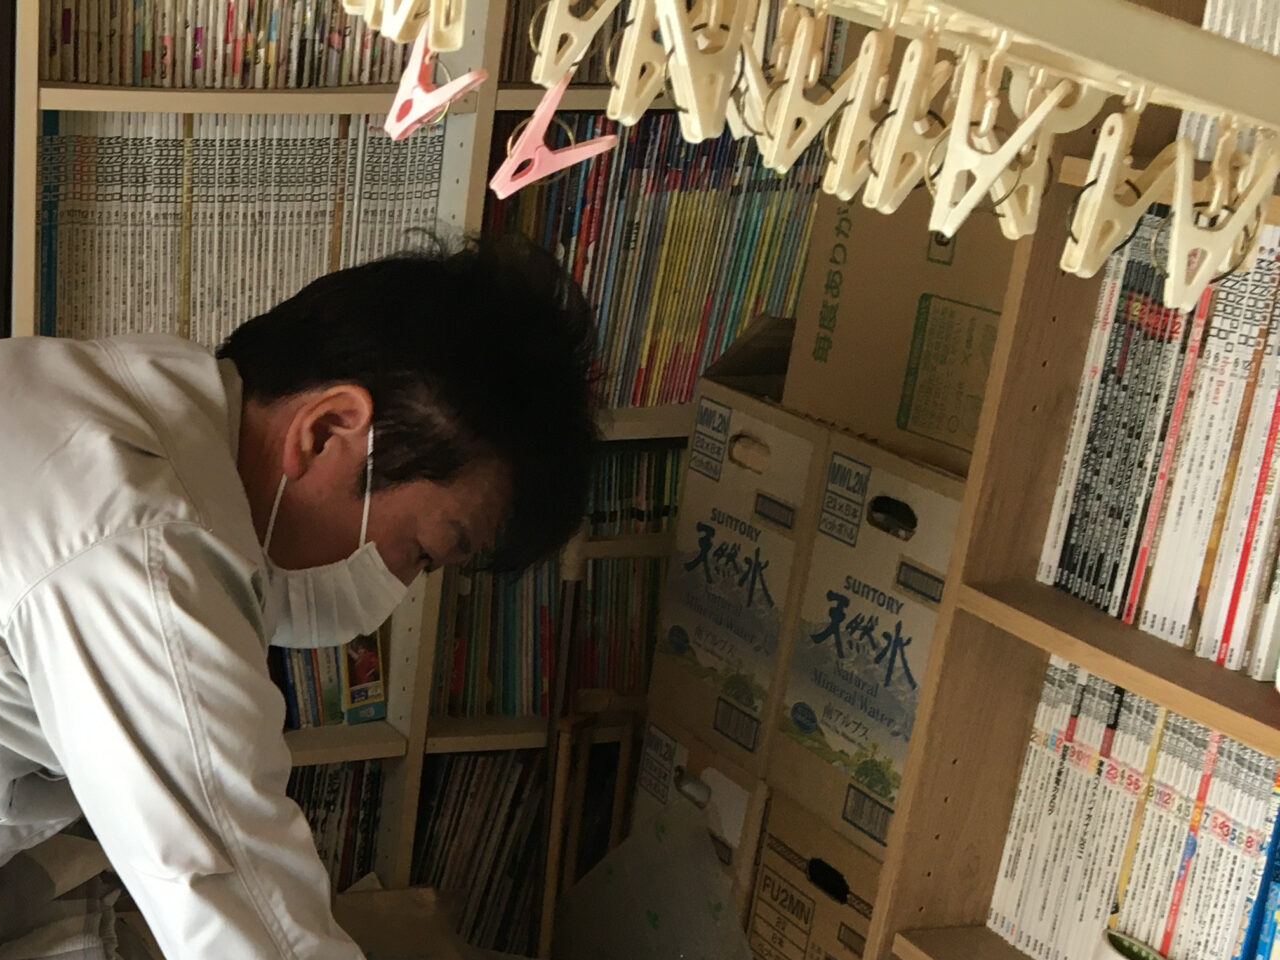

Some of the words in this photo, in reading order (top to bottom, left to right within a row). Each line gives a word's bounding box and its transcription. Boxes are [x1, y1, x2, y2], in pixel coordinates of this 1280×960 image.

[711, 508, 761, 540] SUNTORY
[684, 521, 775, 608] 天然水
[844, 575, 904, 615] SUNTORY
[810, 590, 918, 690] 天然水
[834, 661, 880, 698] Natural
[761, 873, 811, 926] FU2MN
